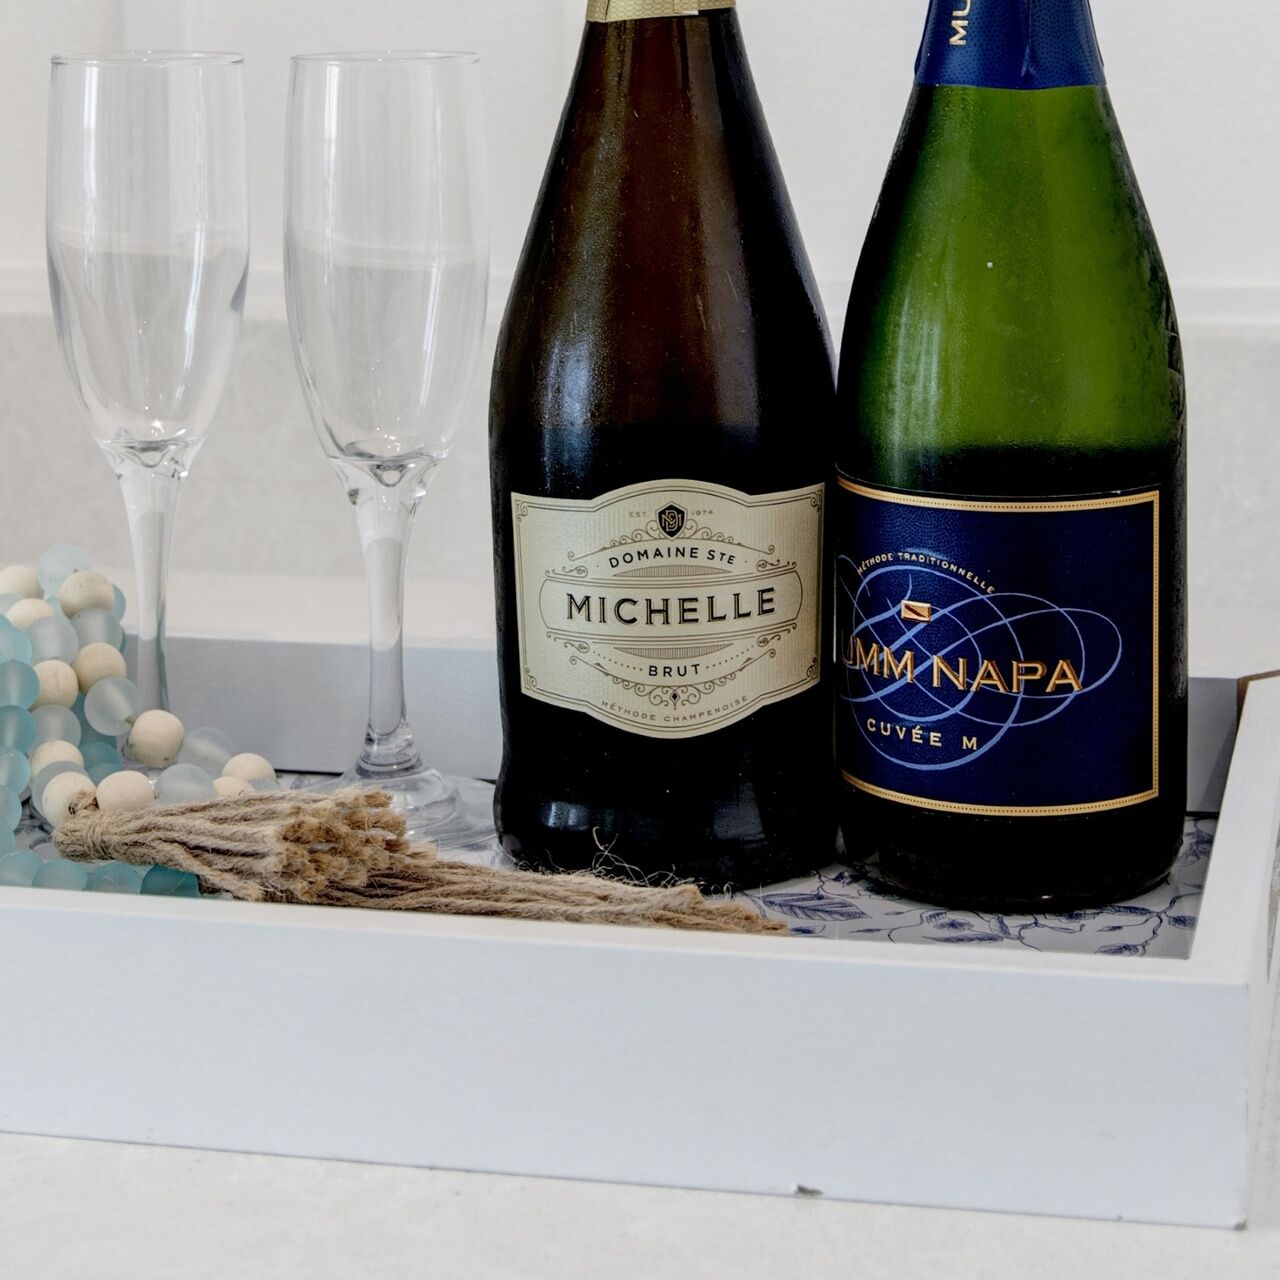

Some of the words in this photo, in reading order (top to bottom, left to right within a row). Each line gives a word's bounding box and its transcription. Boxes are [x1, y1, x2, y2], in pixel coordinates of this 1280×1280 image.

[608, 547, 699, 569] DOMAINE
[707, 549, 736, 565] STE
[897, 552, 996, 594] TRADITIONNELLE
[566, 587, 776, 625] MICHELLE
[648, 664, 701, 677] BRUT
[841, 631, 915, 683] UMM
[932, 654, 1083, 694] NAPA
[601, 700, 657, 721] MÉTHODE
[663, 695, 749, 722] CHAMPENOISE
[867, 718, 942, 747] CUVÉE
[962, 736, 978, 751] M
